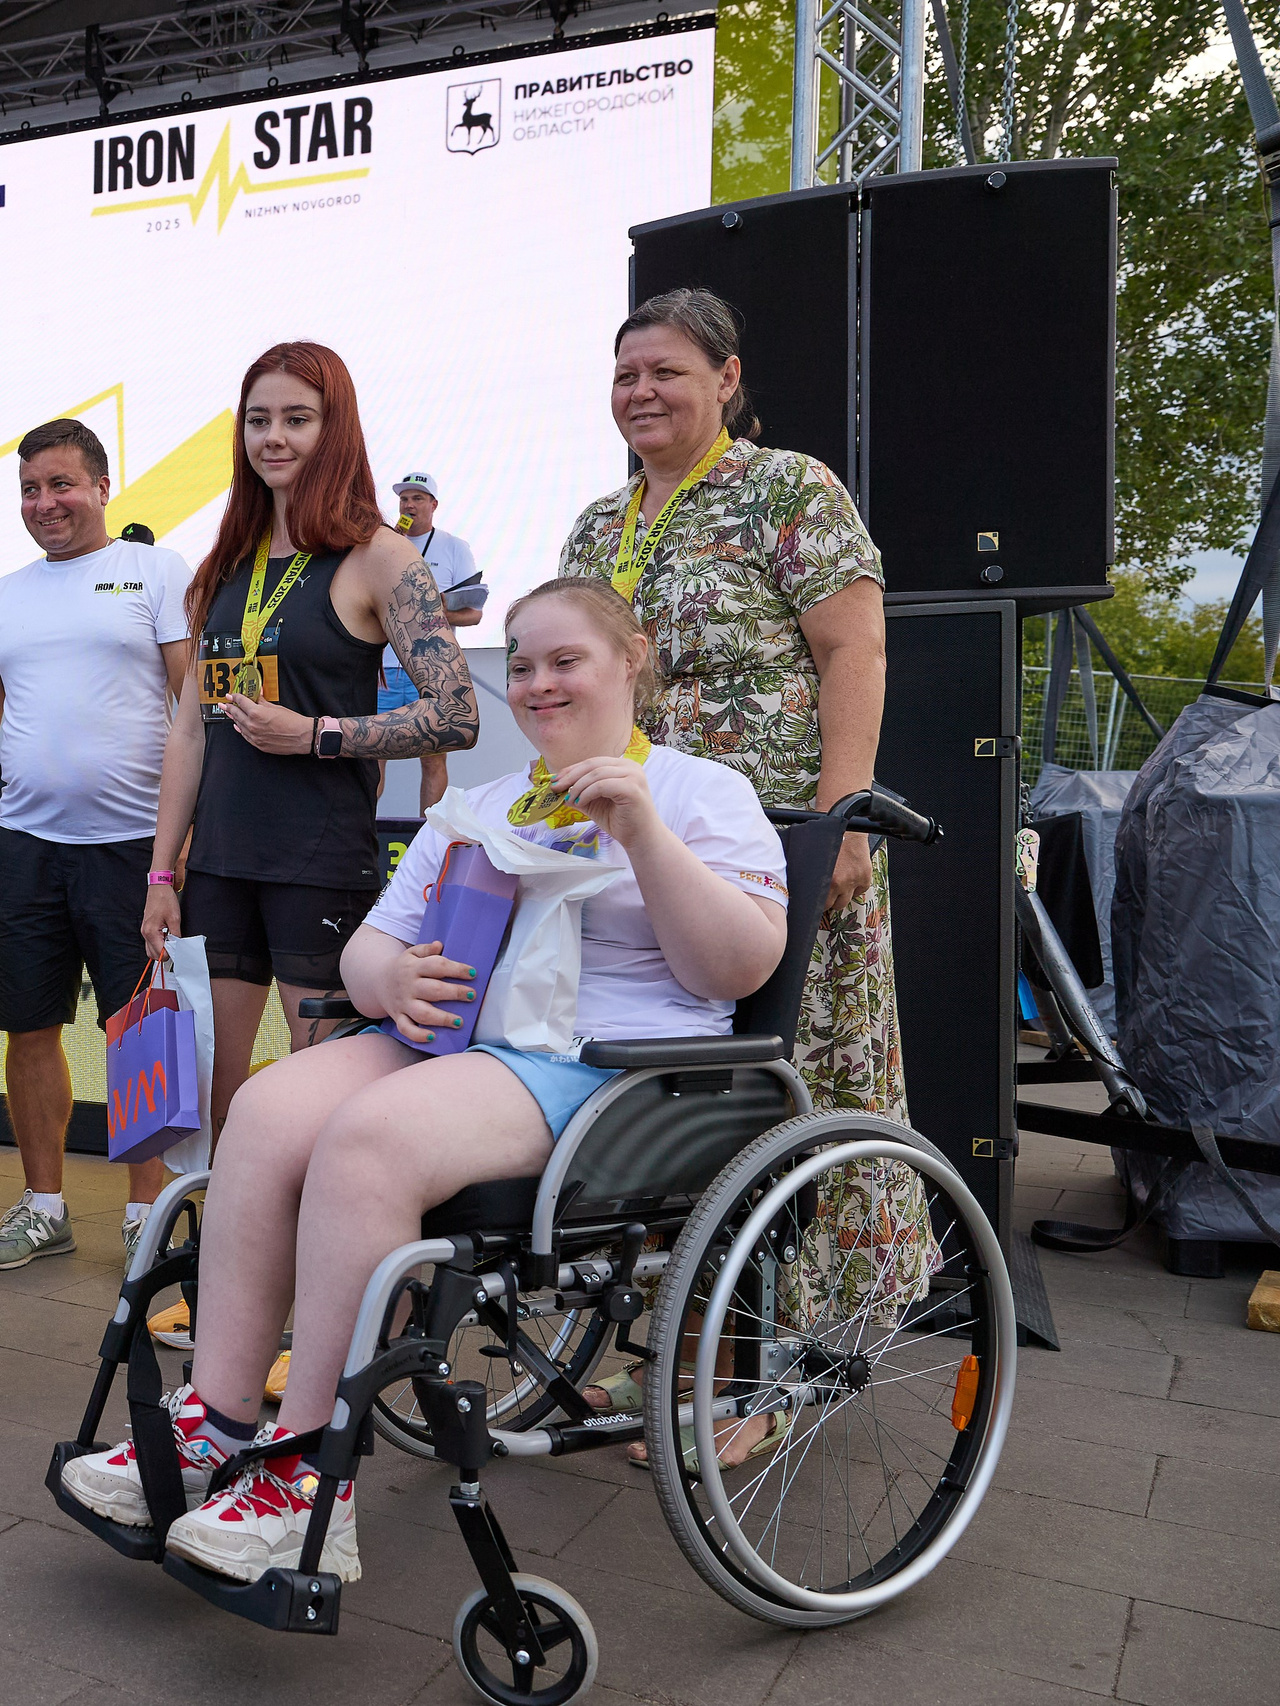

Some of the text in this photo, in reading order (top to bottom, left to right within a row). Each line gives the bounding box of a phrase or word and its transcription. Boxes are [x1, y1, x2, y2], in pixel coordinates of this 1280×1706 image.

[514, 58, 694, 100] ПРАВИТЕЛЬСТВО
[513, 84, 675, 123] НИЖЕГОРОДСКОЙ
[512, 117, 595, 141] ОБЛАСТИ
[93, 96, 374, 195] IRON STAR
[244, 194, 362, 219] NIZHNY NOVGOROD
[146, 218, 181, 233] 2025
[635, 539, 657, 569] 2025
[94, 581, 144, 592] IRON STAR
[266, 552, 308, 610] NSTAR 2025
[522, 794, 538, 814] 1
[107, 1059, 167, 1140] WM
[583, 1412, 633, 1427] ottobock.
